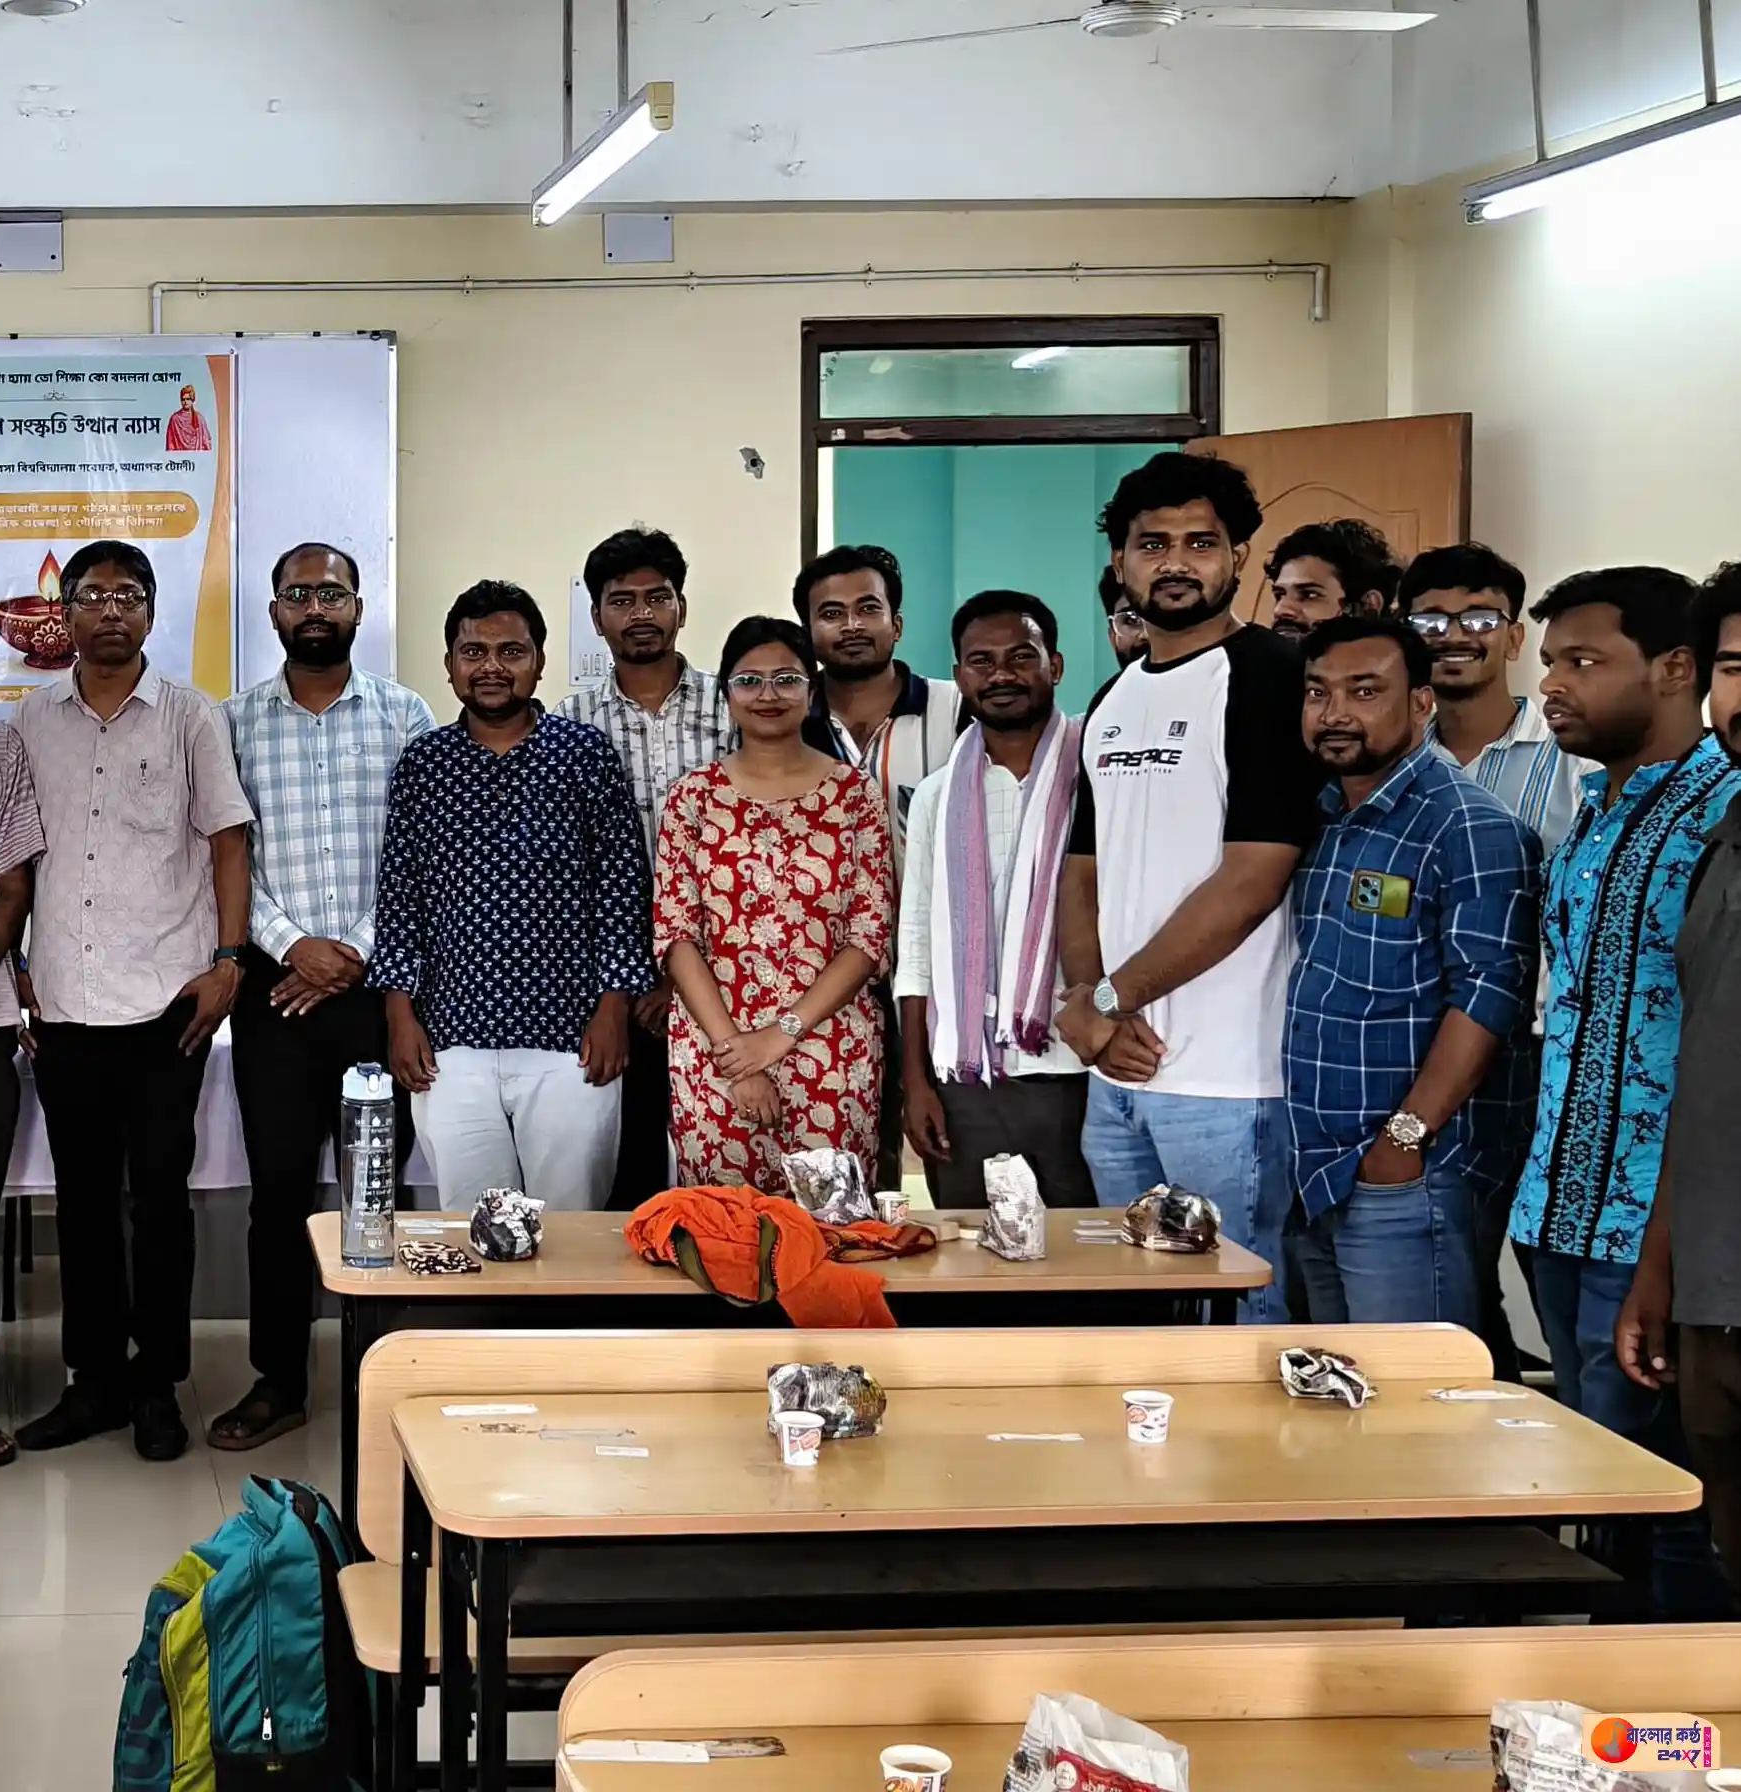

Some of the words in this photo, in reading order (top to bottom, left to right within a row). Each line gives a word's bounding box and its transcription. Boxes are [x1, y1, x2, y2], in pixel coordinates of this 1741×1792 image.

[56, 369, 86, 382] শিক্ষা
[89, 371, 109, 382] কো
[111, 371, 150, 382] বদলনা
[152, 371, 182, 382] হোগা
[7, 411, 68, 438] সংস্কৃতি
[70, 414, 119, 434] উত্থান
[122, 416, 162, 434] ন্যাস
